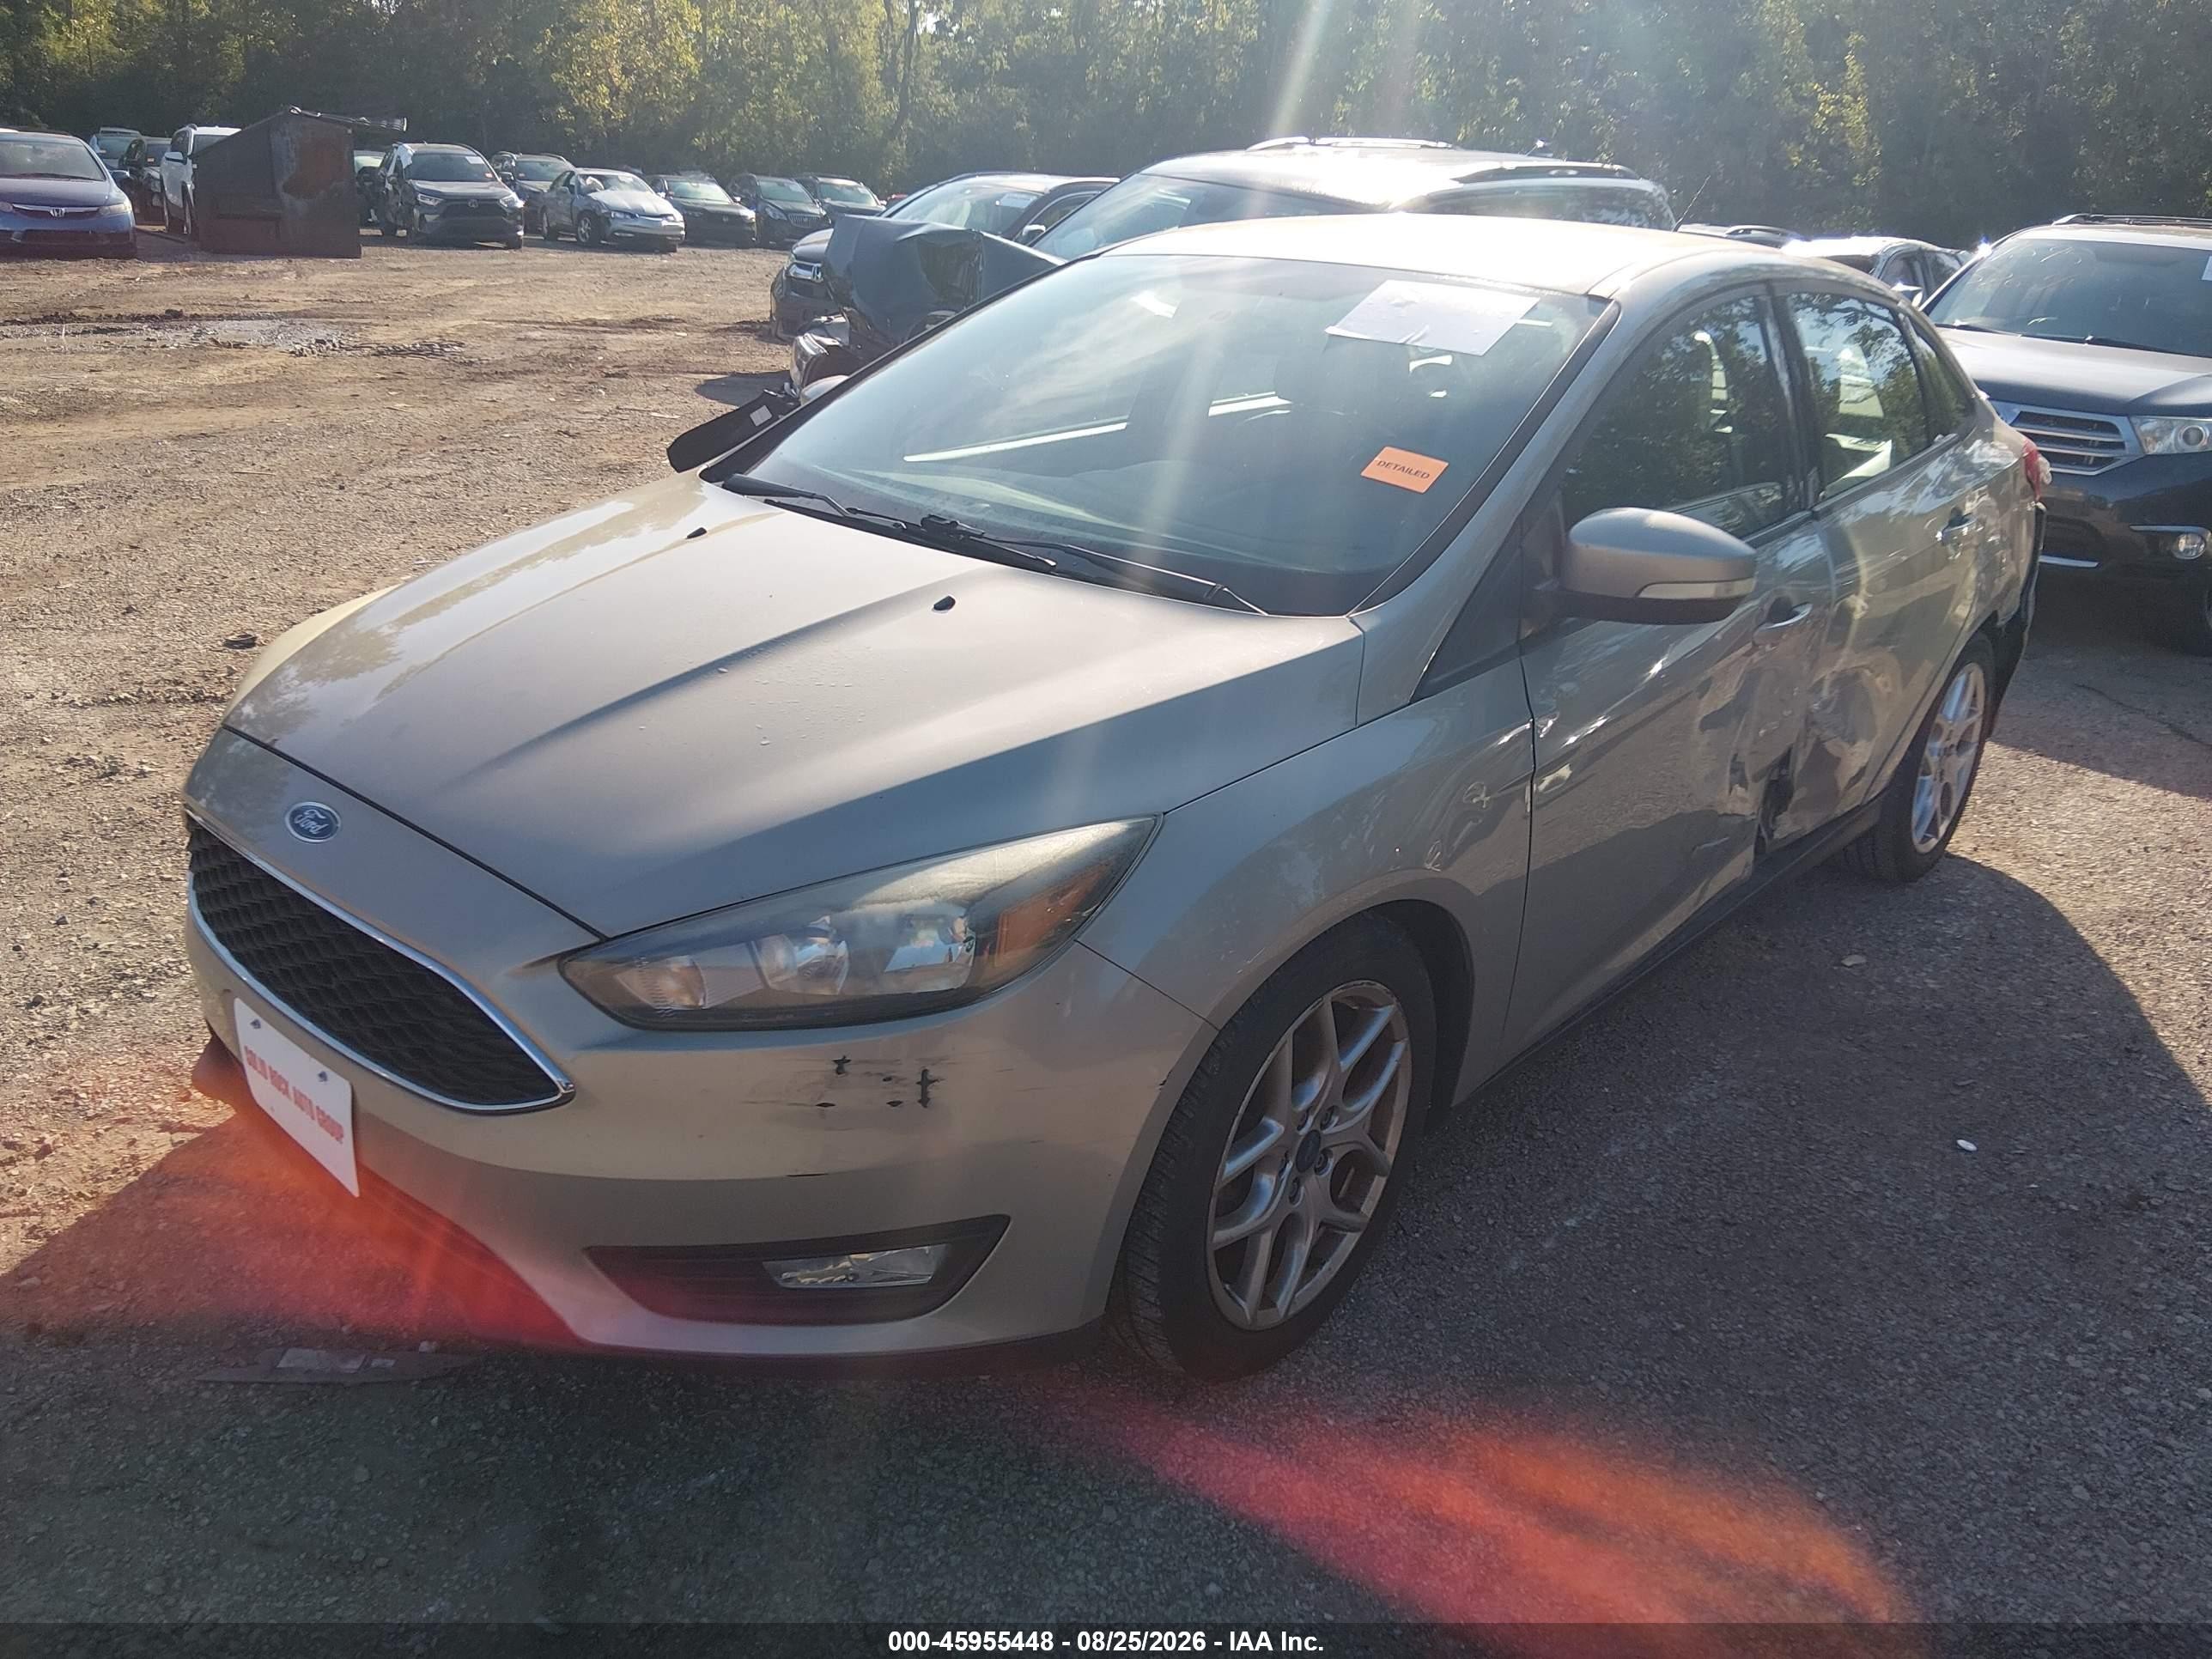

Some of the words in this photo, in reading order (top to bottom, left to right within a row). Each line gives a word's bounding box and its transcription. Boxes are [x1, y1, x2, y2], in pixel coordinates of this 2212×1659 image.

[1376, 459, 1431, 479] DETAILED
[293, 1086, 315, 1121] AUTO
[316, 1105, 344, 1145] GROUP
